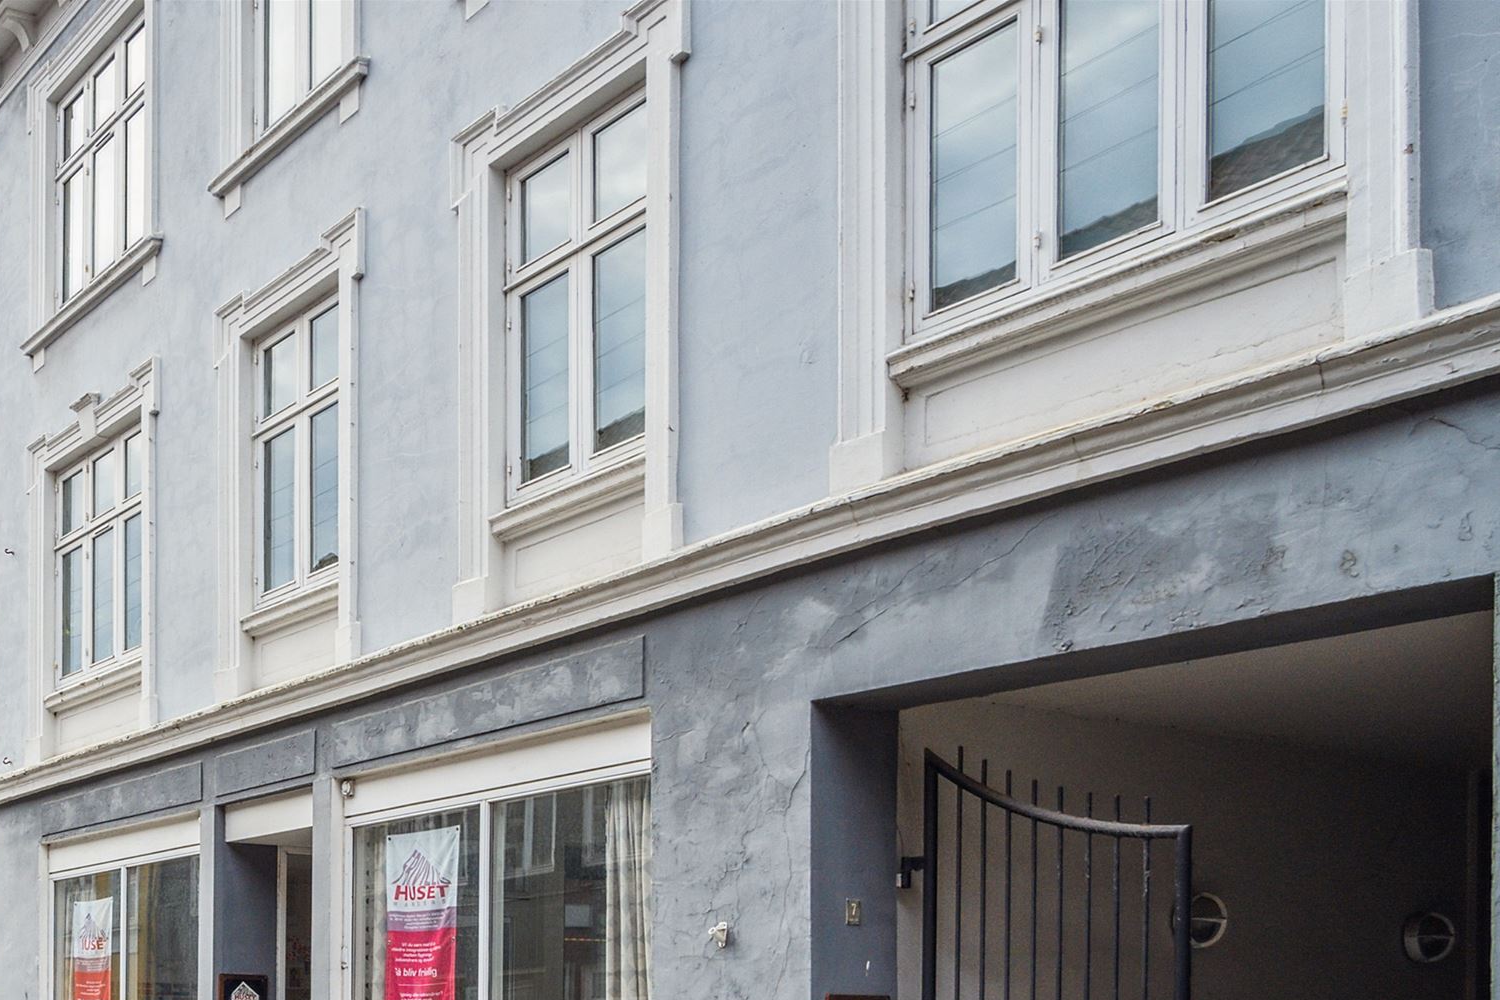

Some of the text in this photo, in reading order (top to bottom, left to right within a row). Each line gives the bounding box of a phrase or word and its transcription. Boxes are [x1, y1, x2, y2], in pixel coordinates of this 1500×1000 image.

[393, 884, 450, 901] HUSET
[850, 902, 857, 916] 7
[403, 967, 417, 977] bliv
